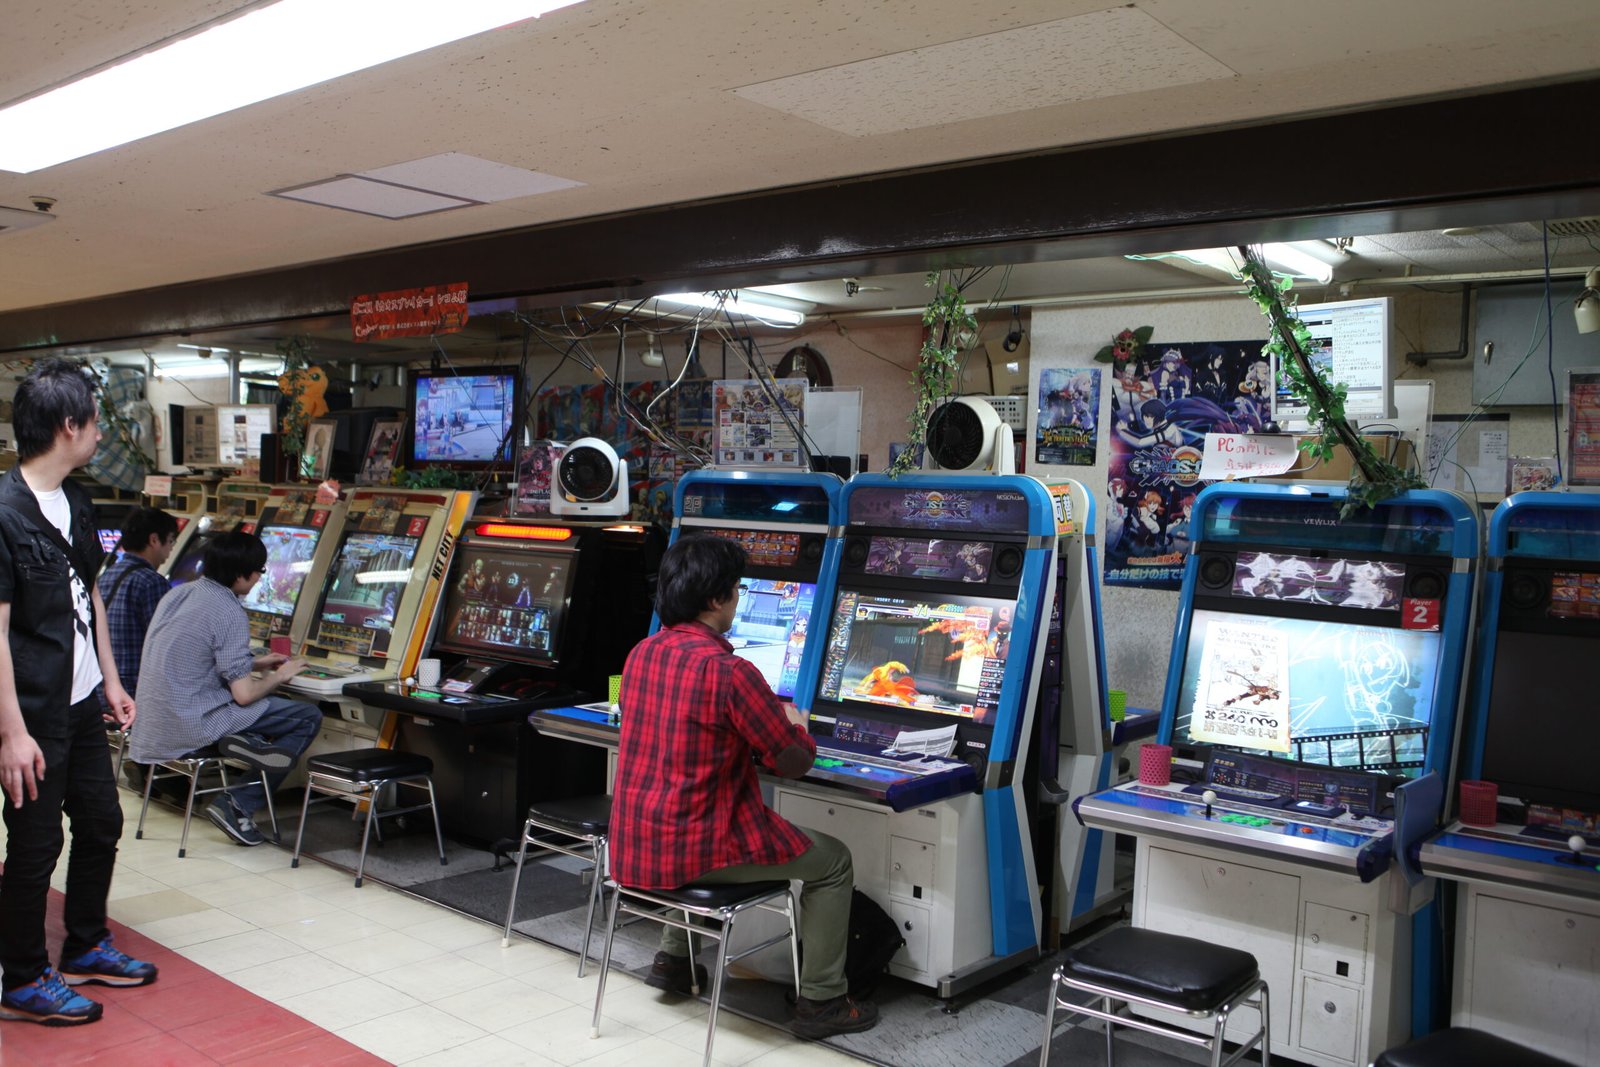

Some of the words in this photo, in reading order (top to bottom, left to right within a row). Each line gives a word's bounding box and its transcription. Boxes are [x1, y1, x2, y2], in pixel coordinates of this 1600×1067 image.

[412, 521, 421, 533] 2
[1303, 517, 1337, 527] VEWLIX
[430, 556, 445, 582] NET
[440, 529, 456, 559] CITY
[1412, 606, 1428, 623] 2
